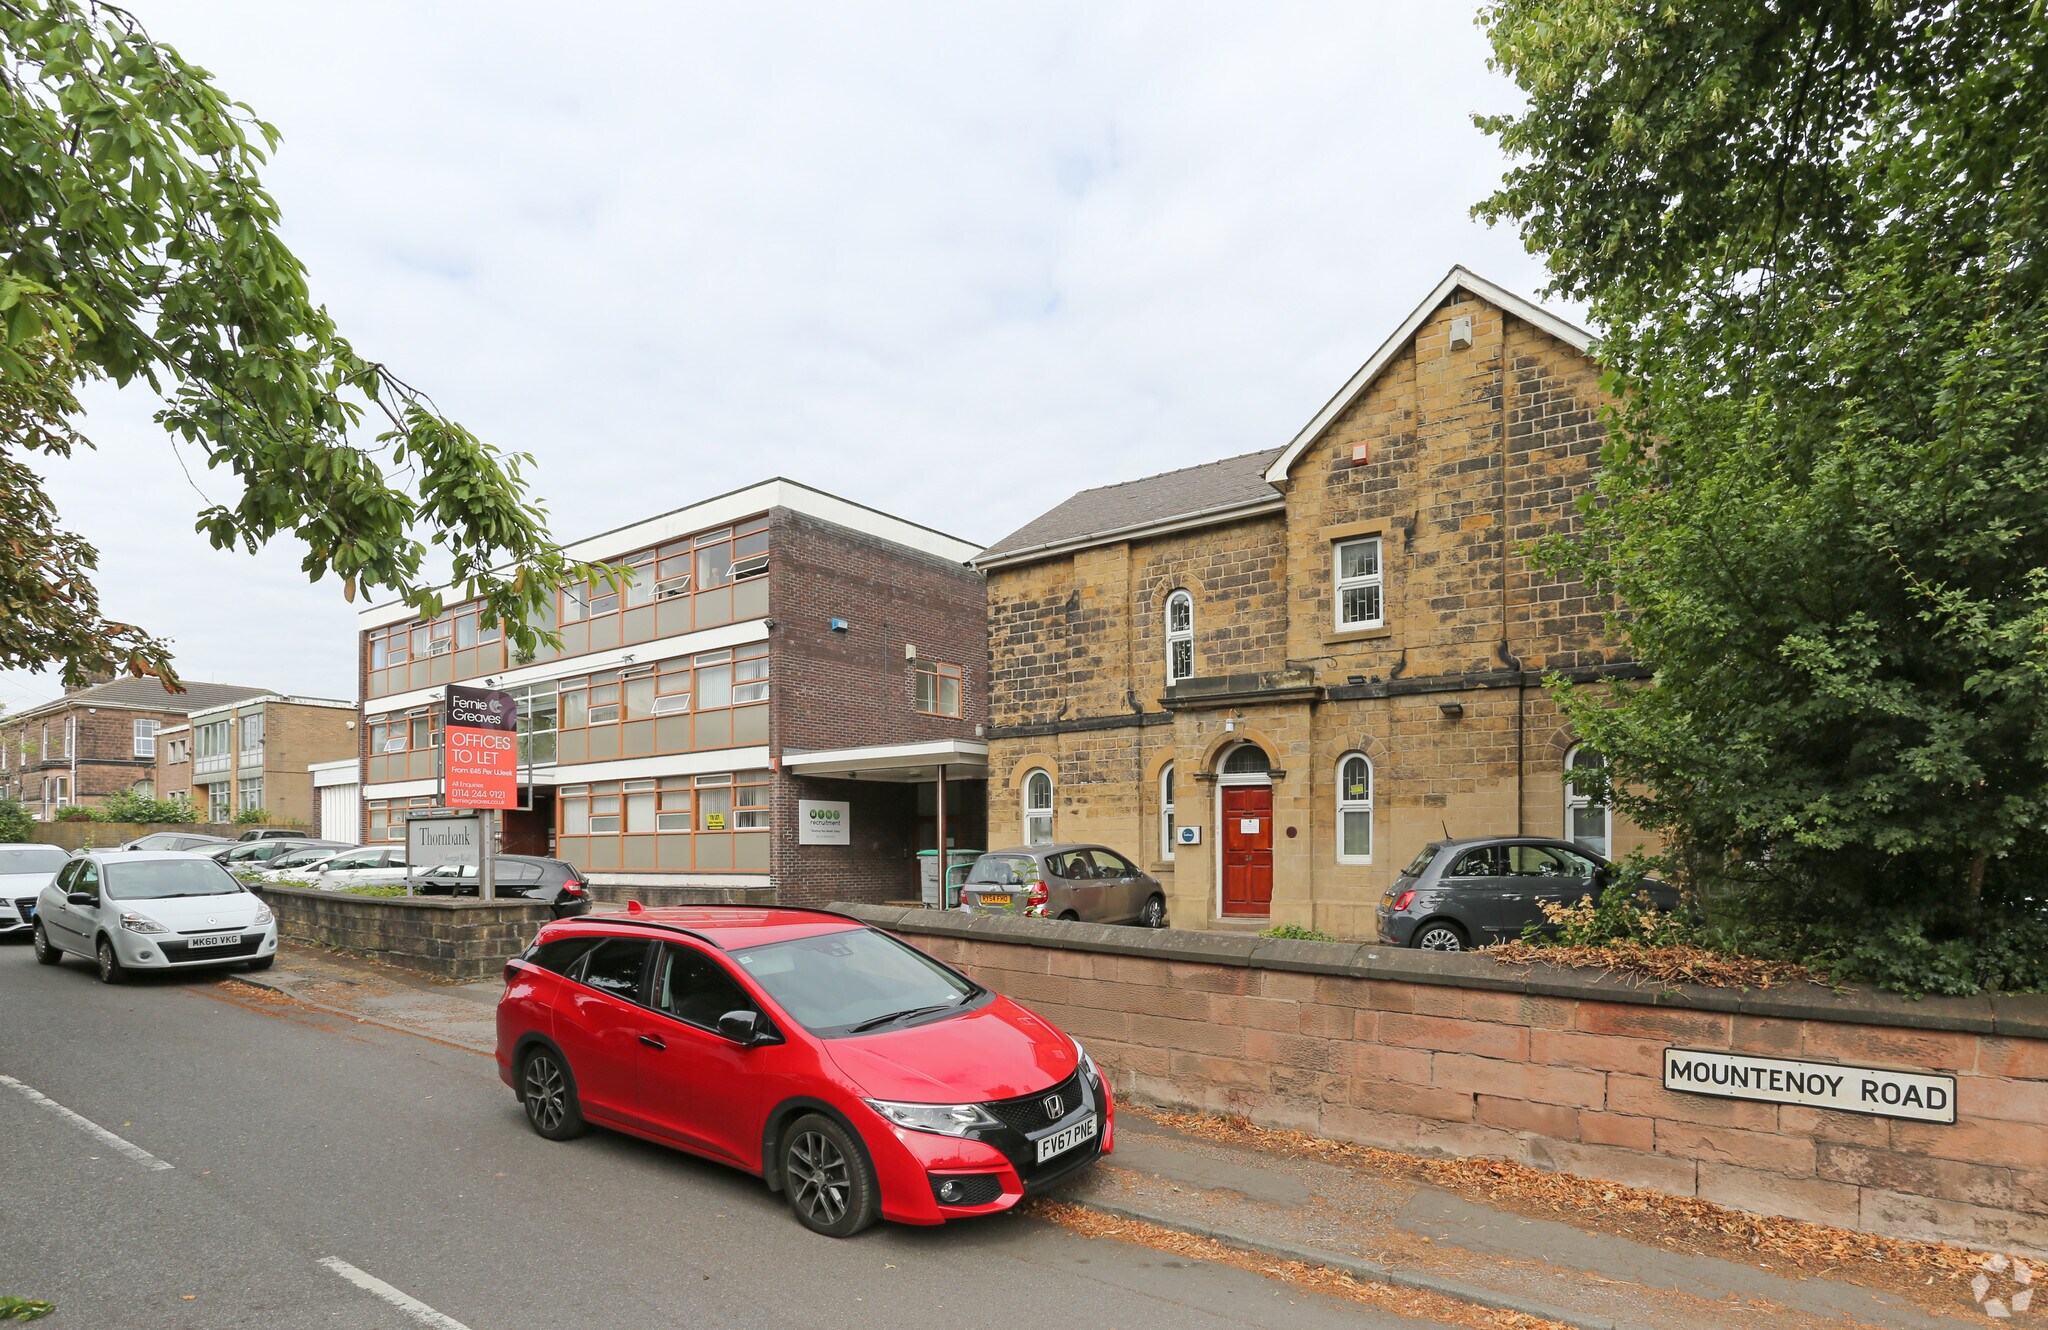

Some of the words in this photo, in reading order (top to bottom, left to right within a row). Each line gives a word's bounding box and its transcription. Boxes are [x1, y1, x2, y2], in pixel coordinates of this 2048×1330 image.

[453, 695, 487, 710] Fernie
[452, 708, 501, 724] Greaves
[451, 732, 511, 750] OFFICES
[451, 748, 473, 763] TO
[477, 751, 499, 765] LET
[451, 766, 469, 774] From
[482, 768, 493, 776] Per
[493, 769, 513, 777] Week
[451, 789, 469, 797] 0114
[471, 790, 487, 798] 244
[489, 791, 506, 799] 9121
[451, 797, 505, 805] ferniegreaves.co.uk
[419, 826, 471, 846] Thornbank
[193, 937, 217, 946] MK60
[220, 935, 237, 943] VKG
[1671, 1060, 1843, 1097] MOUNTENOY
[1861, 1079, 1947, 1110] ROAD
[1043, 1130, 1071, 1157] FV67
[1074, 1119, 1093, 1142] PNE
